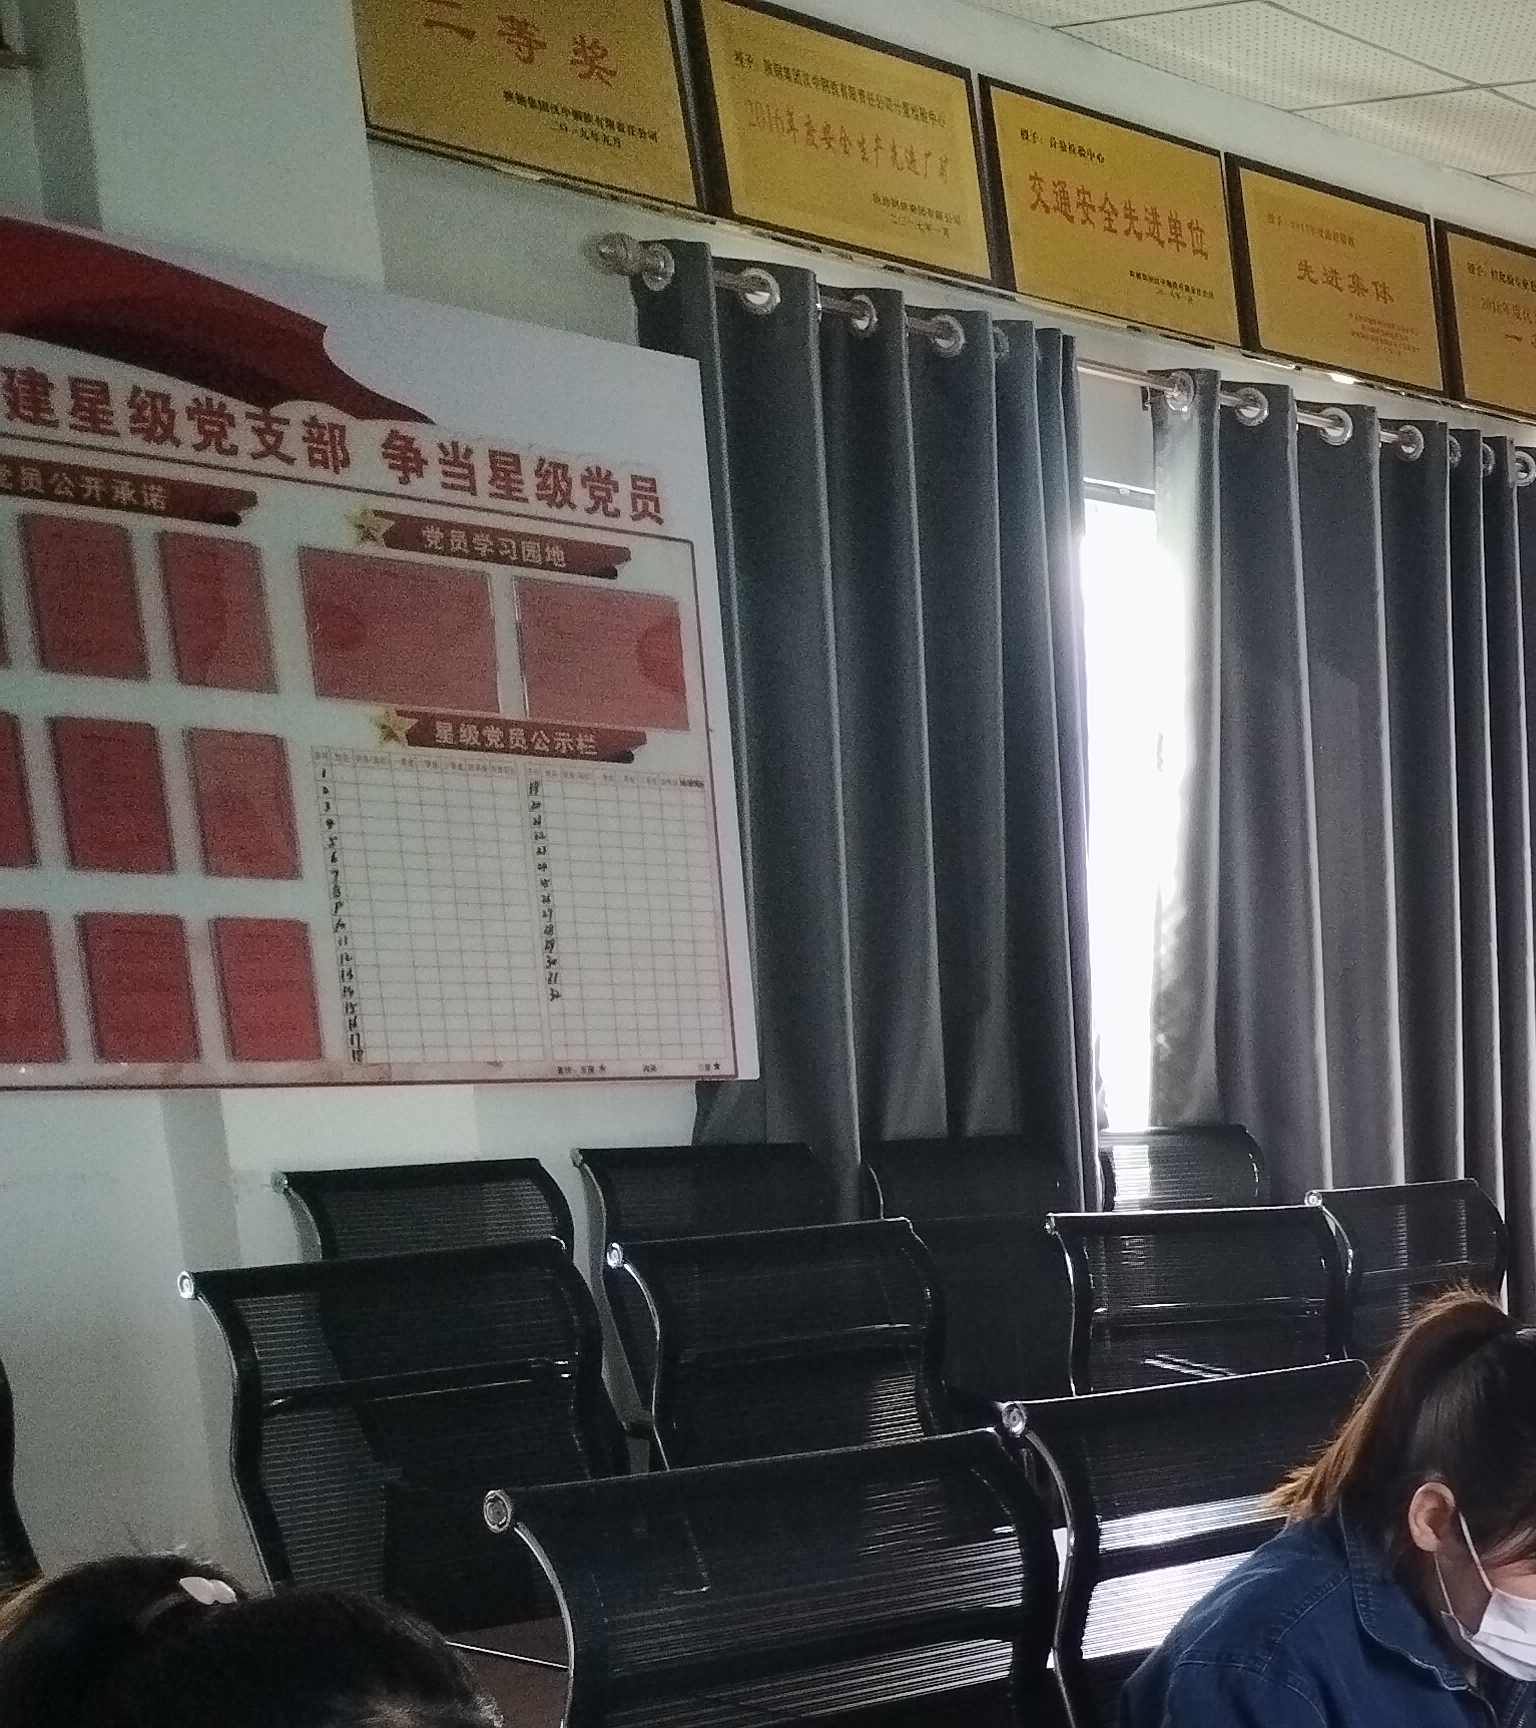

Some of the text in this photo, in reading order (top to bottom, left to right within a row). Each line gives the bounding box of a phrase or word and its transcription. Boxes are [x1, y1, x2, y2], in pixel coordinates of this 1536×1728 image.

[1028, 169, 1209, 261] 交通安全先进单位
[1296, 259, 1395, 305] 先进集体
[1, 366, 666, 526] 建星级党支部 争当星级党员
[421, 524, 567, 570] 党员学习园地
[434, 720, 598, 757] 星级党员公示栏
